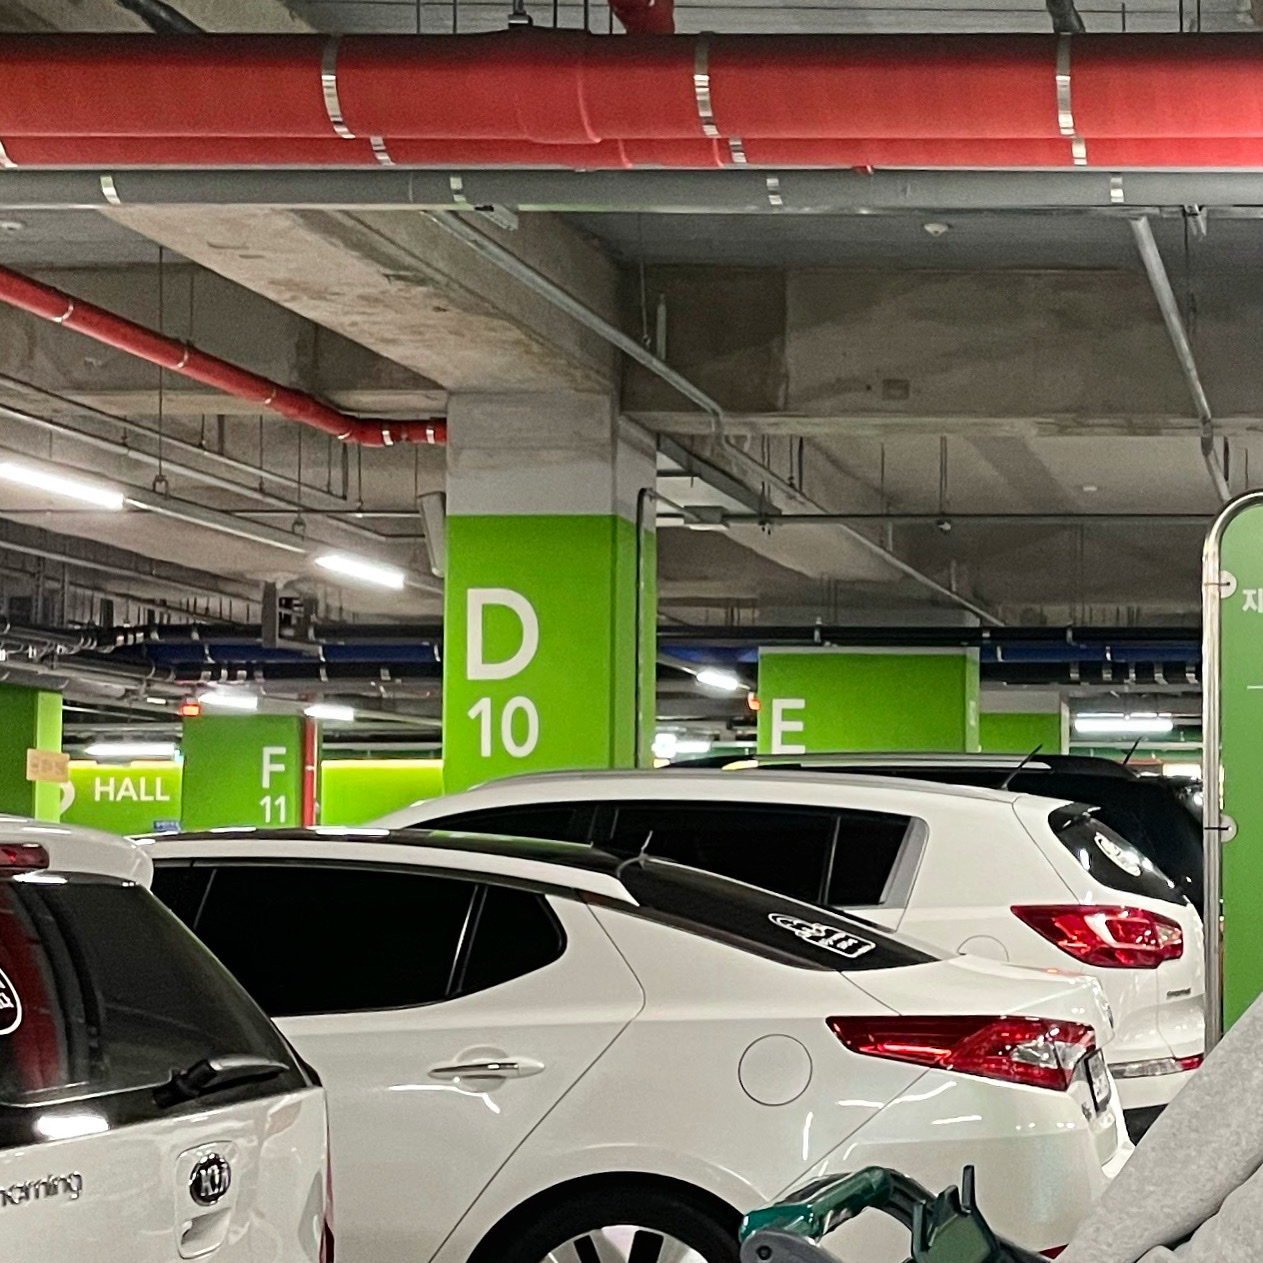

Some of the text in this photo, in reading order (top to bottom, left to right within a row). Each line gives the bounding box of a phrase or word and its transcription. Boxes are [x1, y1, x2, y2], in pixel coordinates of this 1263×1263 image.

[466, 587, 540, 681] D
[467, 695, 540, 758] 10
[770, 698, 807, 755] E
[94, 776, 171, 802] HALL
[261, 745, 287, 789] F
[259, 794, 287, 824] 11
